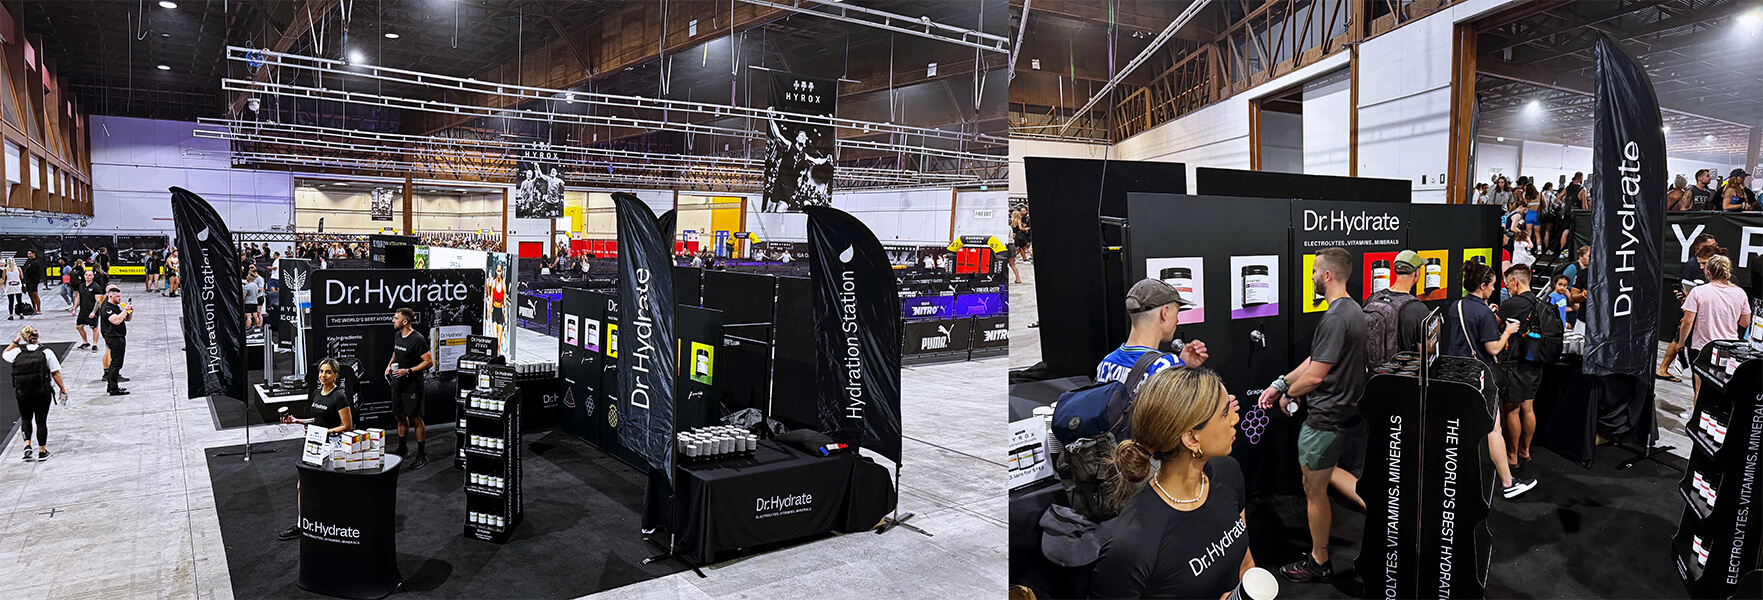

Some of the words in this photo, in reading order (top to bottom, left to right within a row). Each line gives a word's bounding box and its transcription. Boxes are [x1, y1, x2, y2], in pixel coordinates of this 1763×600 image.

[785, 92, 821, 104] HYROX
[525, 151, 559, 160] HYROX
[1615, 140, 1641, 273] Hydrate
[201, 247, 215, 301] Station
[1613, 279, 1634, 317] Dr
[632, 267, 655, 373] Hydrate
[839, 270, 858, 333] Station
[911, 305, 938, 316] NITRO
[205, 303, 221, 374] Hydration
[631, 376, 650, 410] Dr
[843, 337, 866, 419] Hydration
[1388, 415, 1402, 483] MINERALS
[1446, 418, 1459, 445] THE
[1443, 447, 1458, 510] WORLD'S
[1441, 511, 1455, 544] BEST
[1438, 545, 1453, 600] HYDRATI
